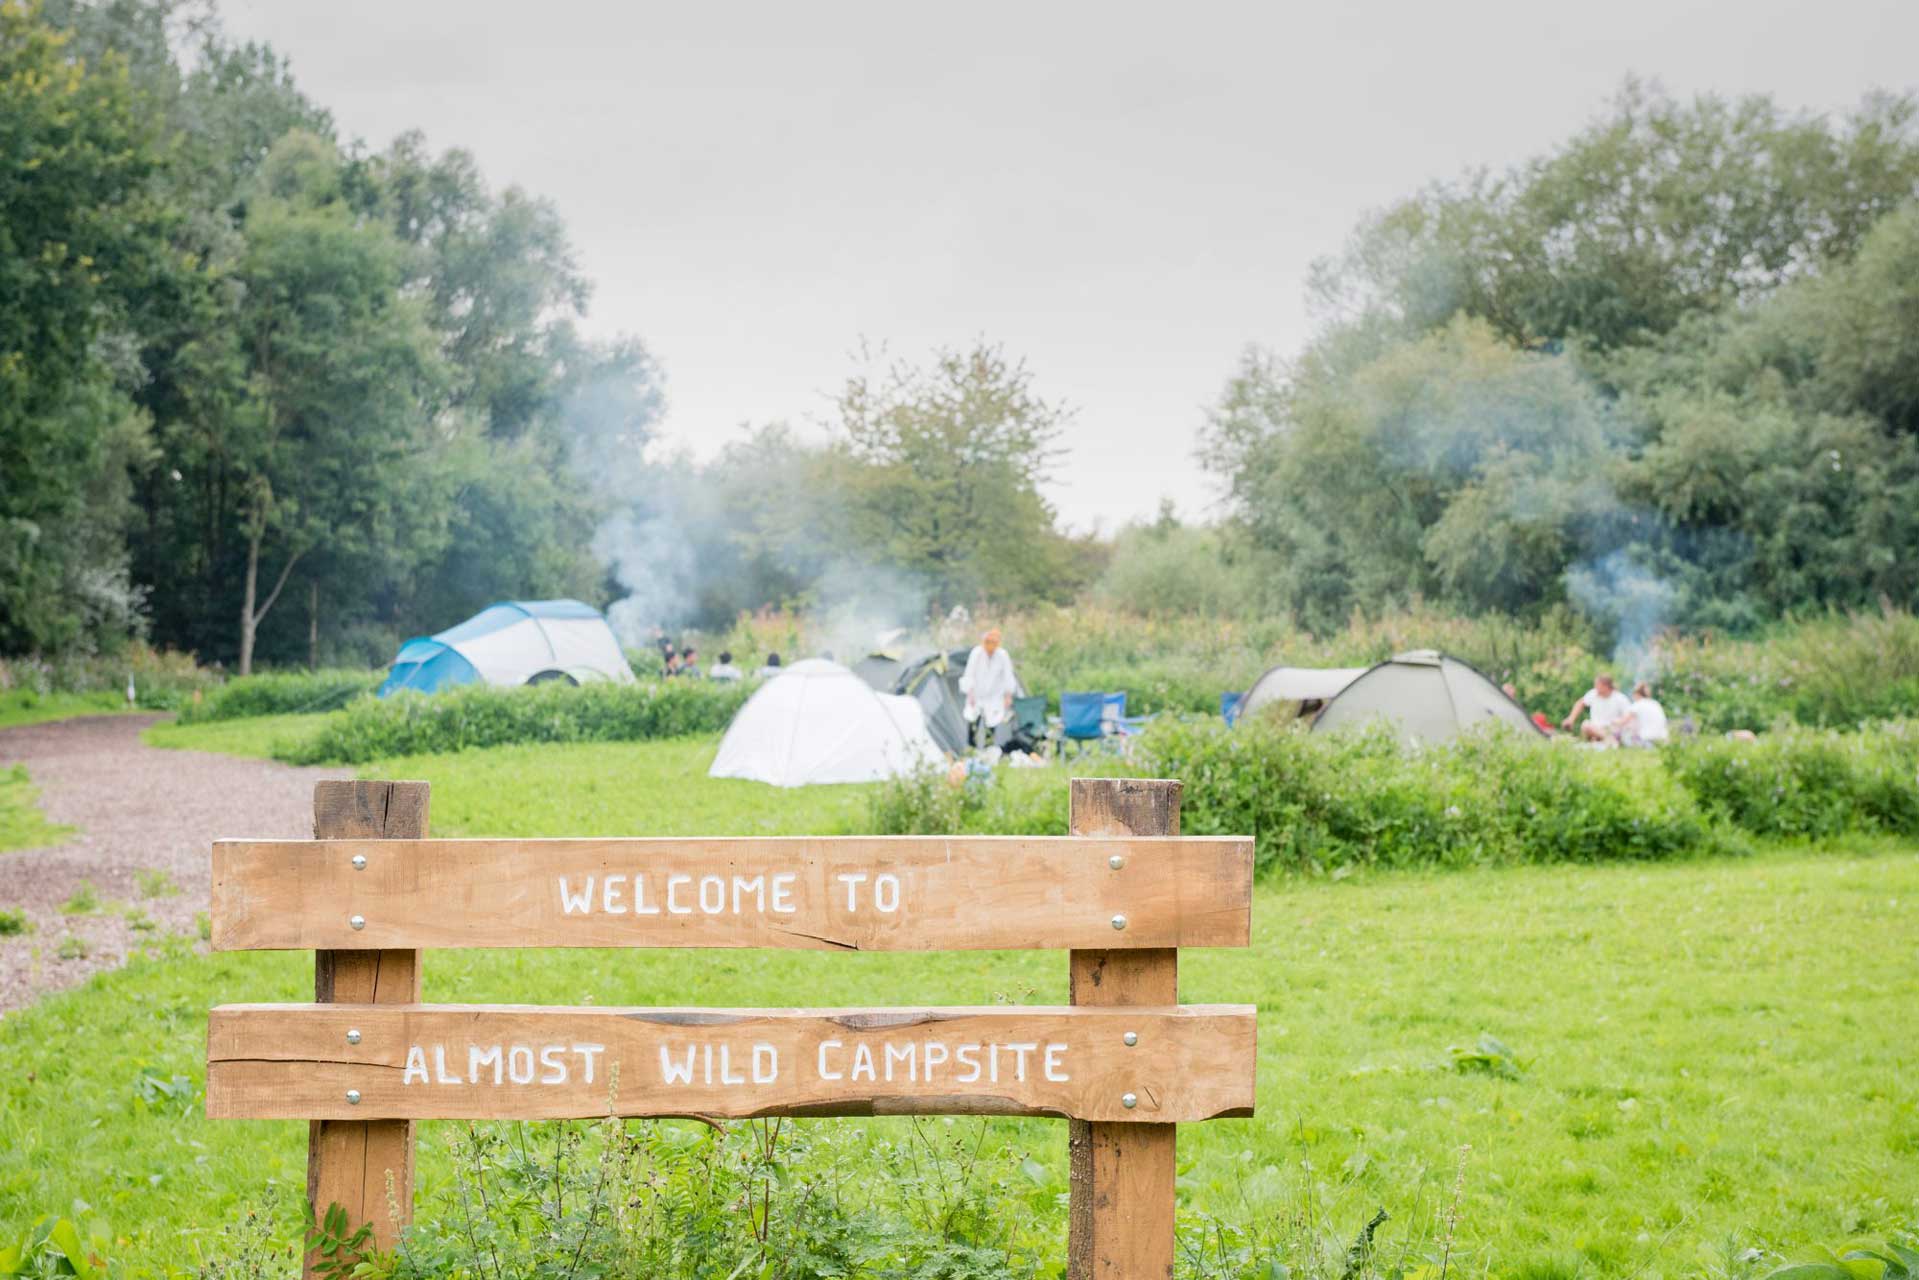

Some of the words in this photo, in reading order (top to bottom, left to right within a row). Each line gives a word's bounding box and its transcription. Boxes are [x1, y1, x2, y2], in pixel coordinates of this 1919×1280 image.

[558, 872, 797, 914] WELCOME
[837, 872, 901, 913] TO
[403, 1043, 605, 1085] ALMOST
[659, 1043, 778, 1085] WILD
[817, 1039, 1071, 1083] CAMPSITE
